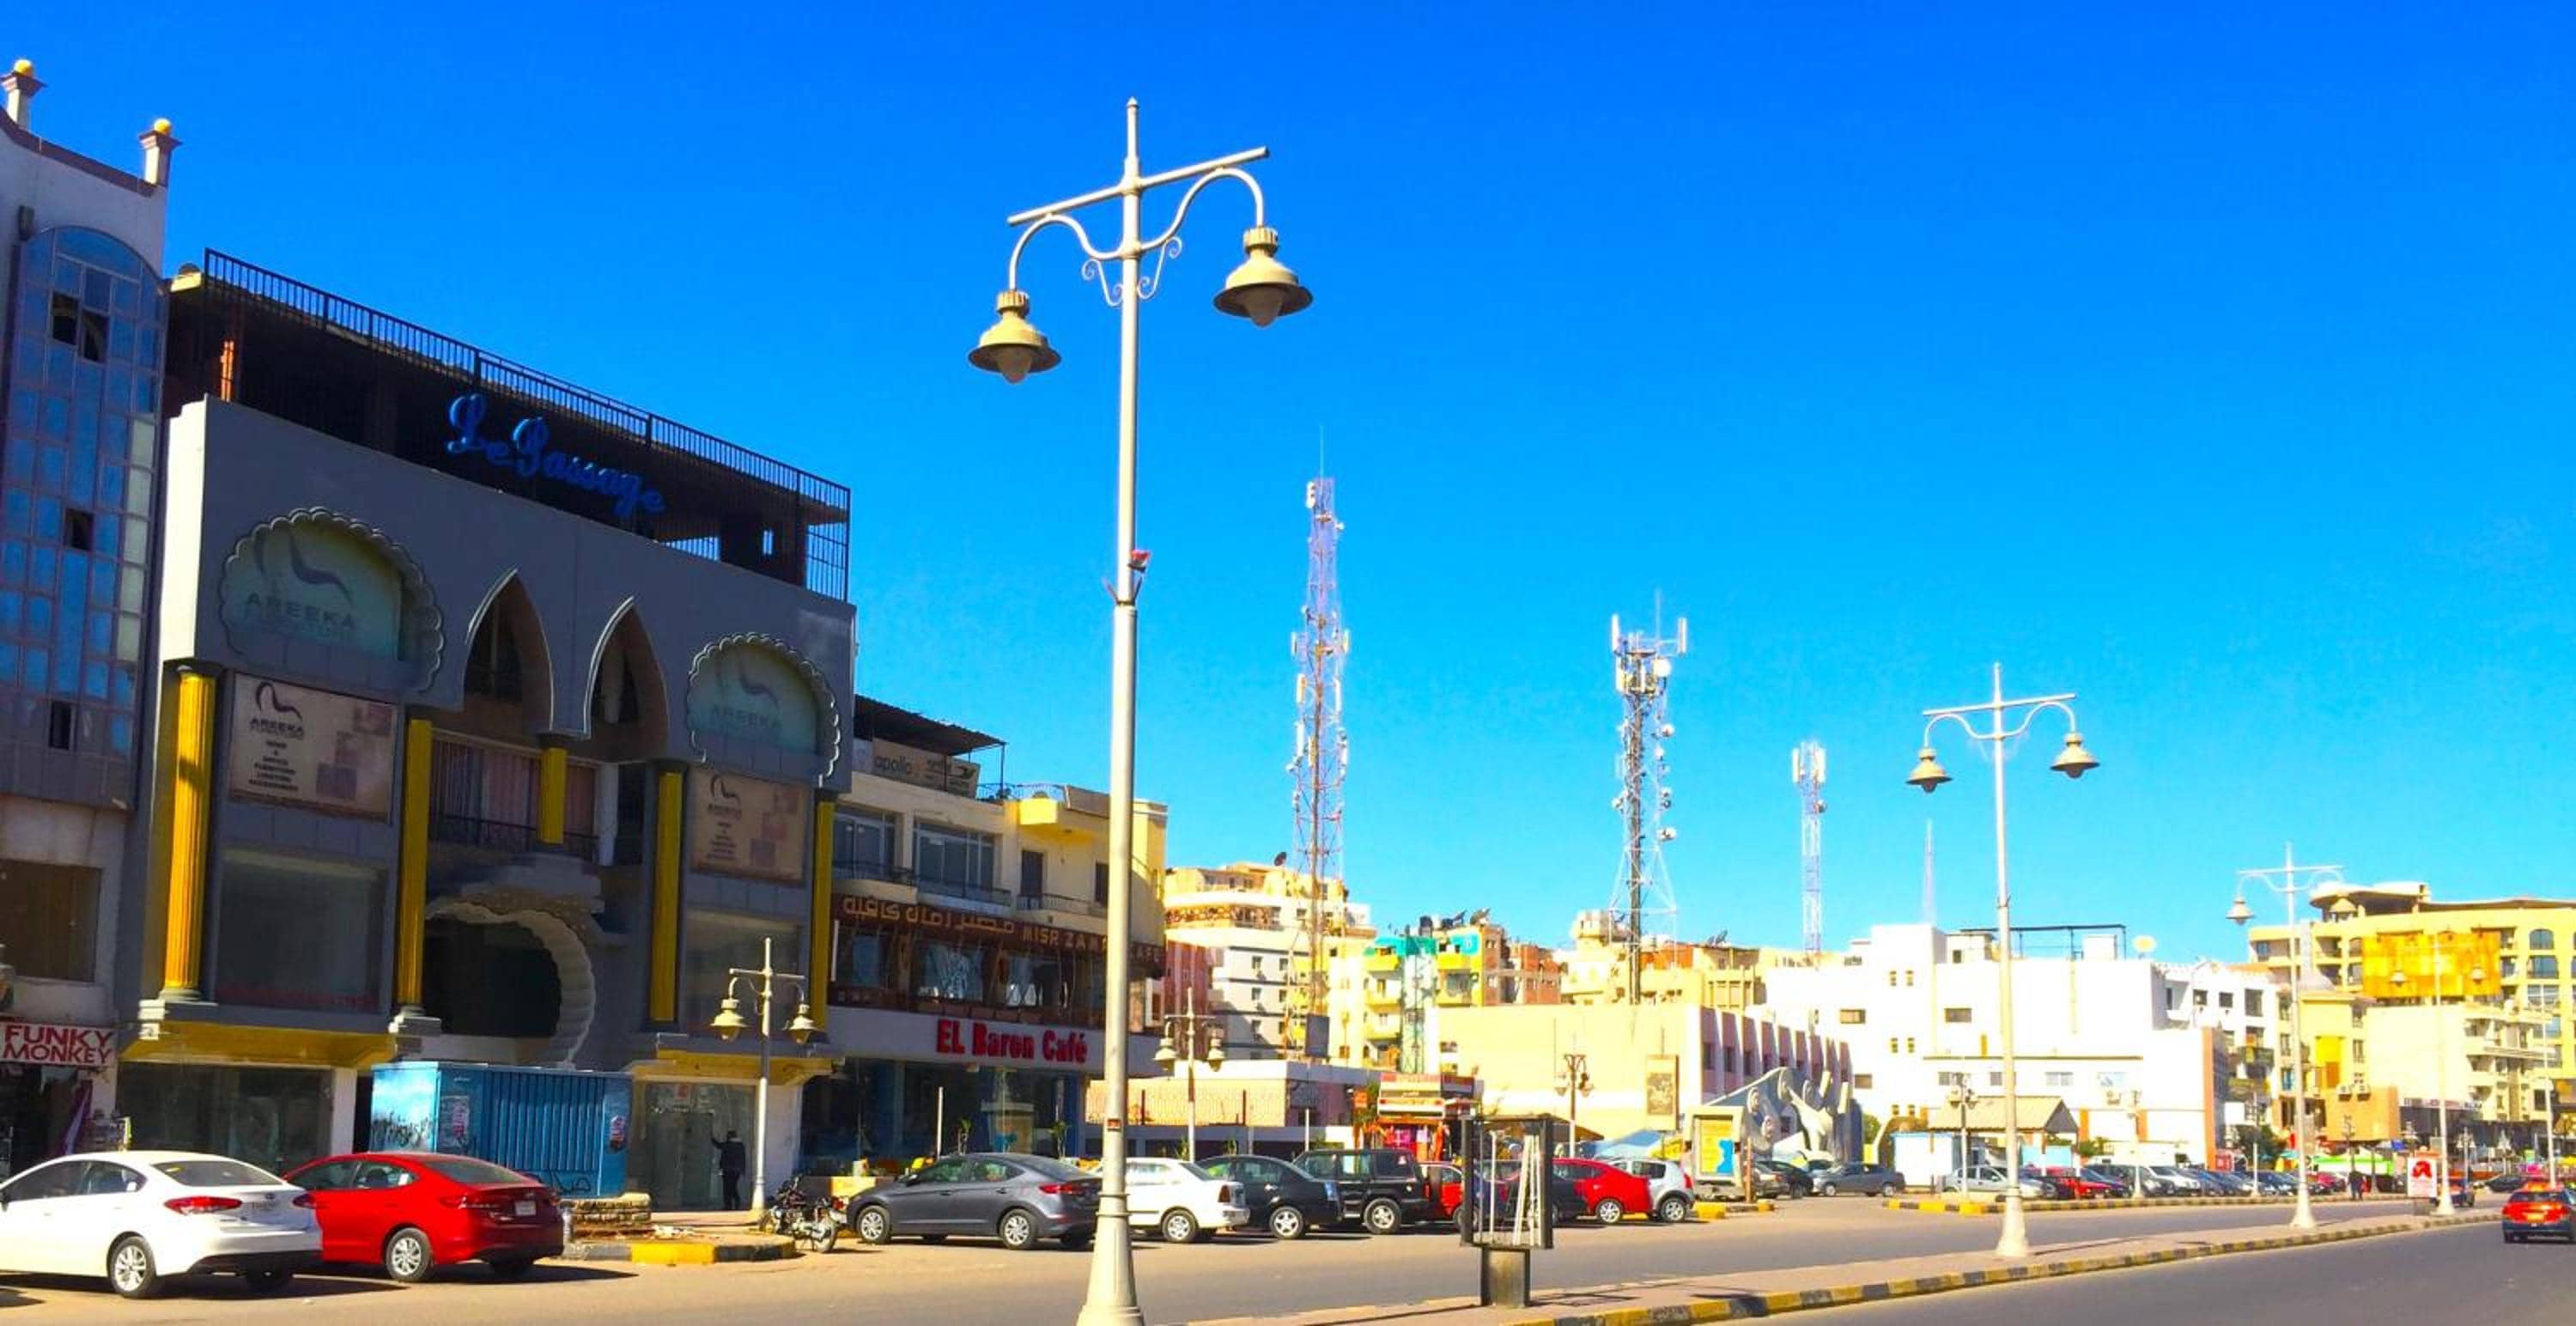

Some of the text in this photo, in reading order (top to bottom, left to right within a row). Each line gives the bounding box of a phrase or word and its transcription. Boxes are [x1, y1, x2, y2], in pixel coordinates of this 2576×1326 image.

[4, 1024, 114, 1046] FUNKY
[937, 1019, 1088, 1064] EL Baron Café
[3, 1042, 112, 1064] MONKEY
